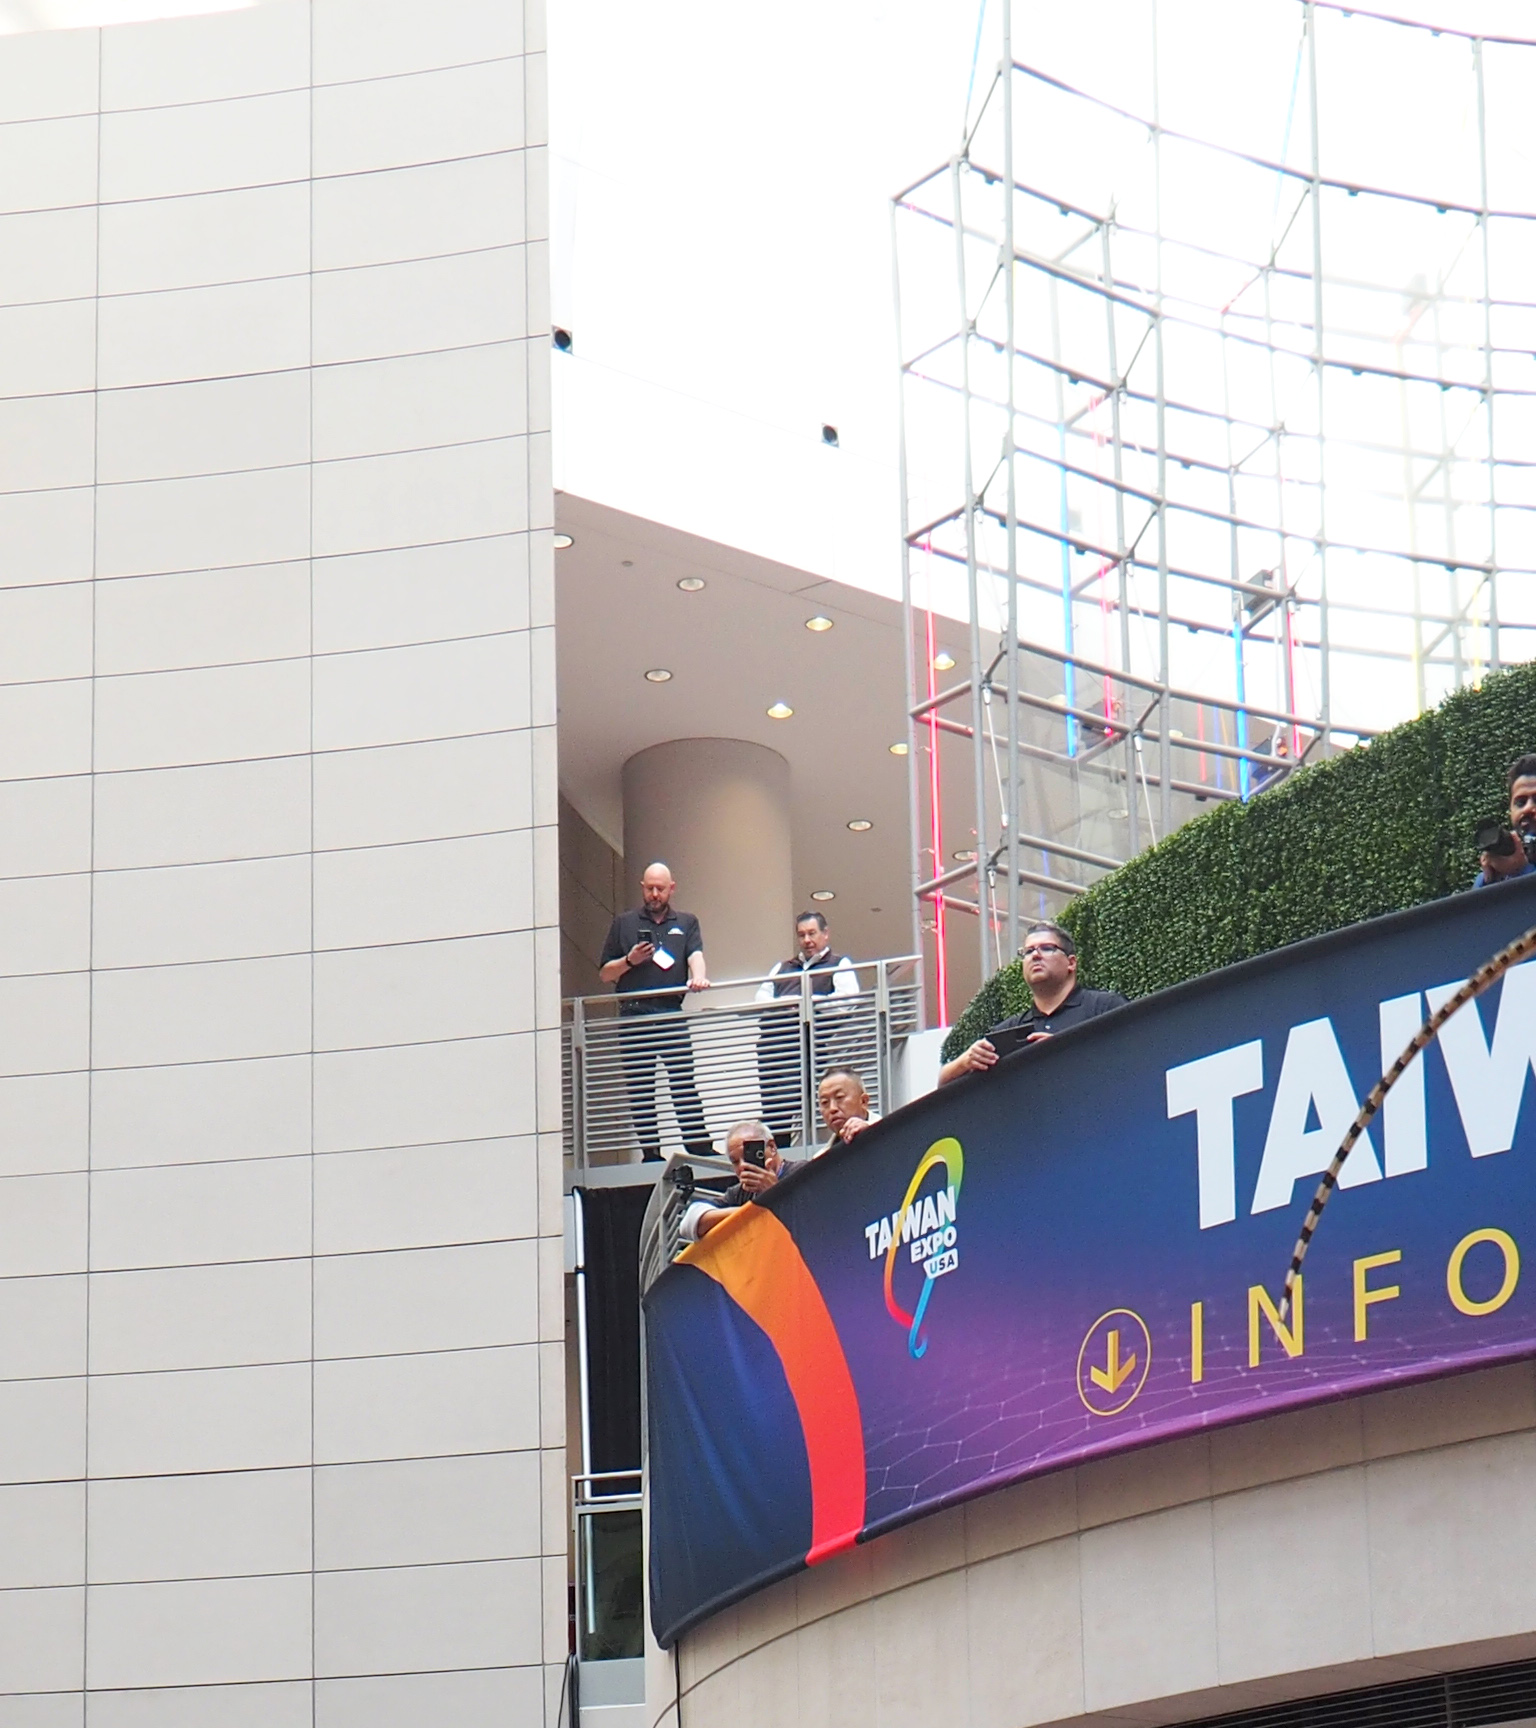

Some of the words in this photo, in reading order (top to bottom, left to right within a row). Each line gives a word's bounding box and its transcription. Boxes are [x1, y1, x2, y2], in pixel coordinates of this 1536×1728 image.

[865, 1185, 956, 1260] TAIWAN
[910, 1226, 957, 1263] EXPO
[929, 1253, 956, 1274] USA
